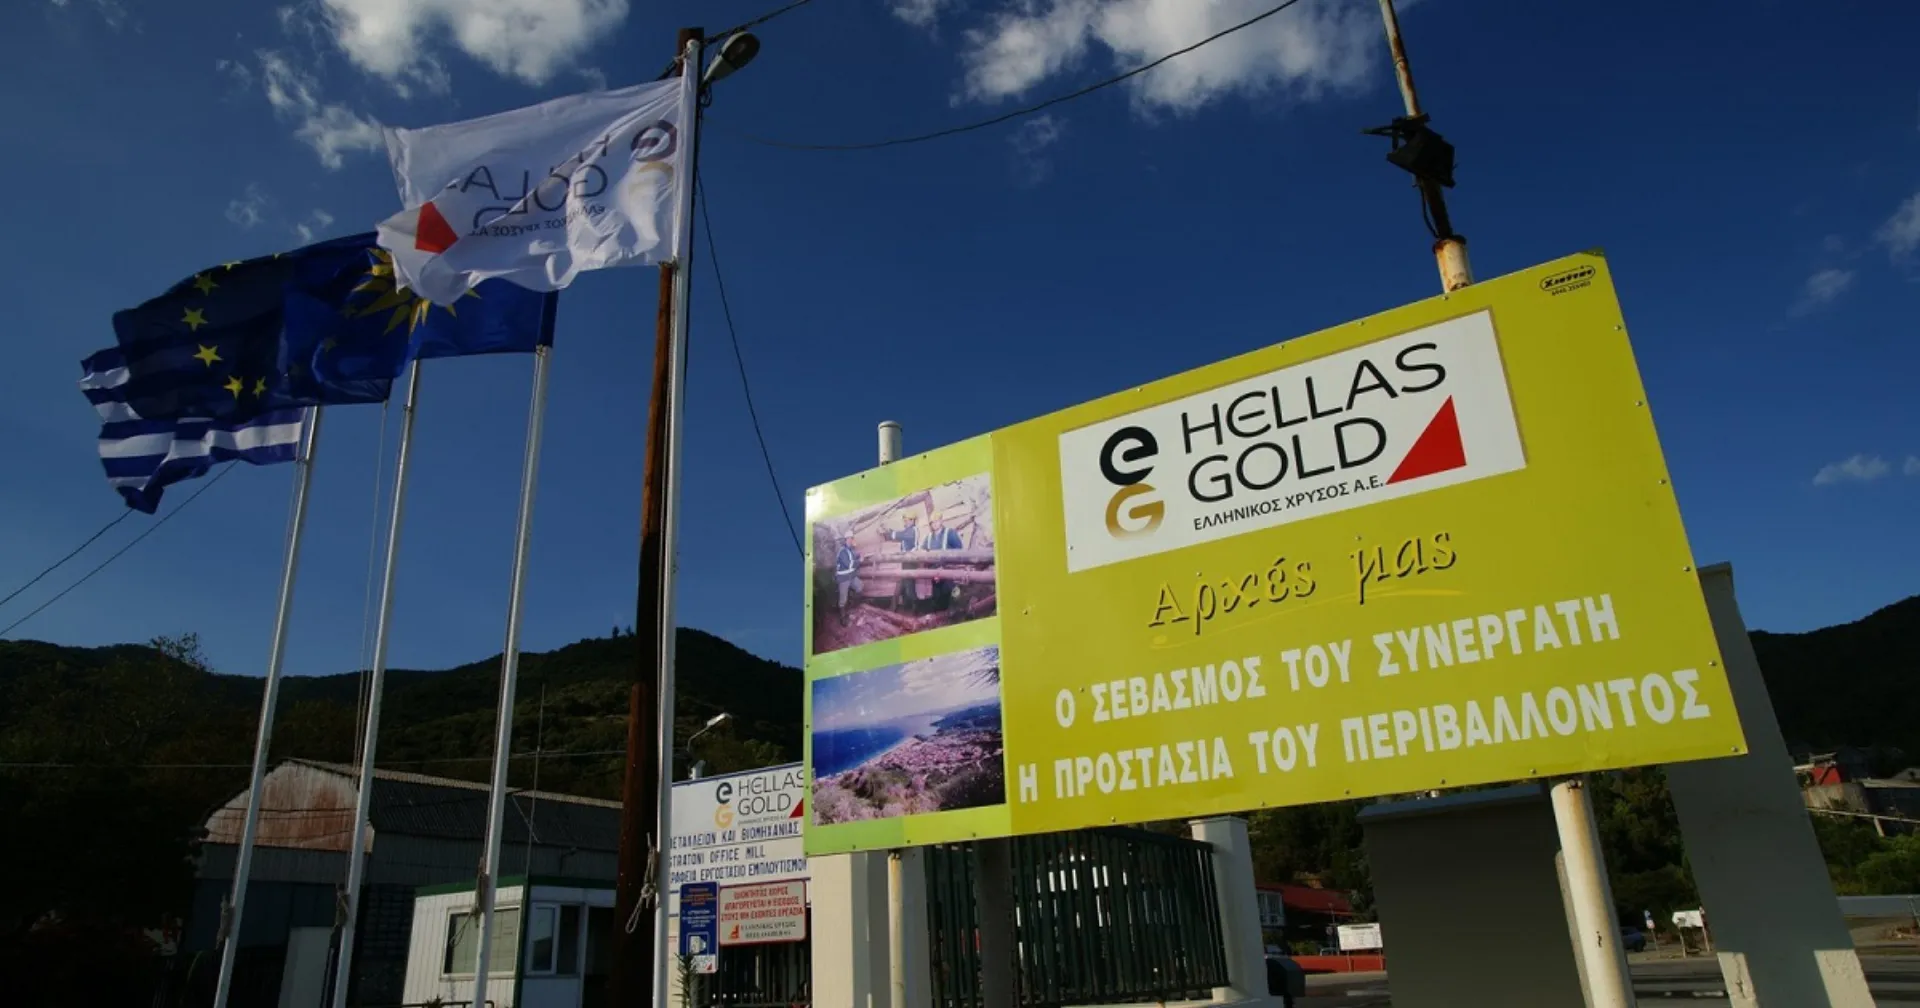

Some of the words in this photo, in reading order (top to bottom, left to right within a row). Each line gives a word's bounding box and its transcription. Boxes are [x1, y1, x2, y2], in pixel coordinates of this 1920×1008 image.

[1181, 342, 1447, 454] HELLAS
[1188, 417, 1387, 502] GOLD
[1193, 498, 1282, 531] ΕΛΛΗΝΙΚΟΣ
[1285, 482, 1350, 509] ΧΡΥΣΟΣ
[1354, 475, 1385, 494] Α.Ε.
[1055, 688, 1076, 728] Ο
[1091, 655, 1266, 723] ΣΕΒΑΣΜΟΣ
[1281, 639, 1352, 692] ΤΟΥ
[1373, 593, 1620, 678] ΣΥΝΕΡΓΑΤΗ
[1019, 763, 1038, 803] Η
[1054, 736, 1234, 799] ΠΡΟΣΤΑΣΙΑ
[1248, 723, 1319, 774] ΤΟΥ
[1340, 668, 1711, 763] ΠΕΡΙΒΑΛΛΟΝΤΟΣ
[738, 793, 791, 816] GOLD
[710, 847, 740, 863] OFFICE
